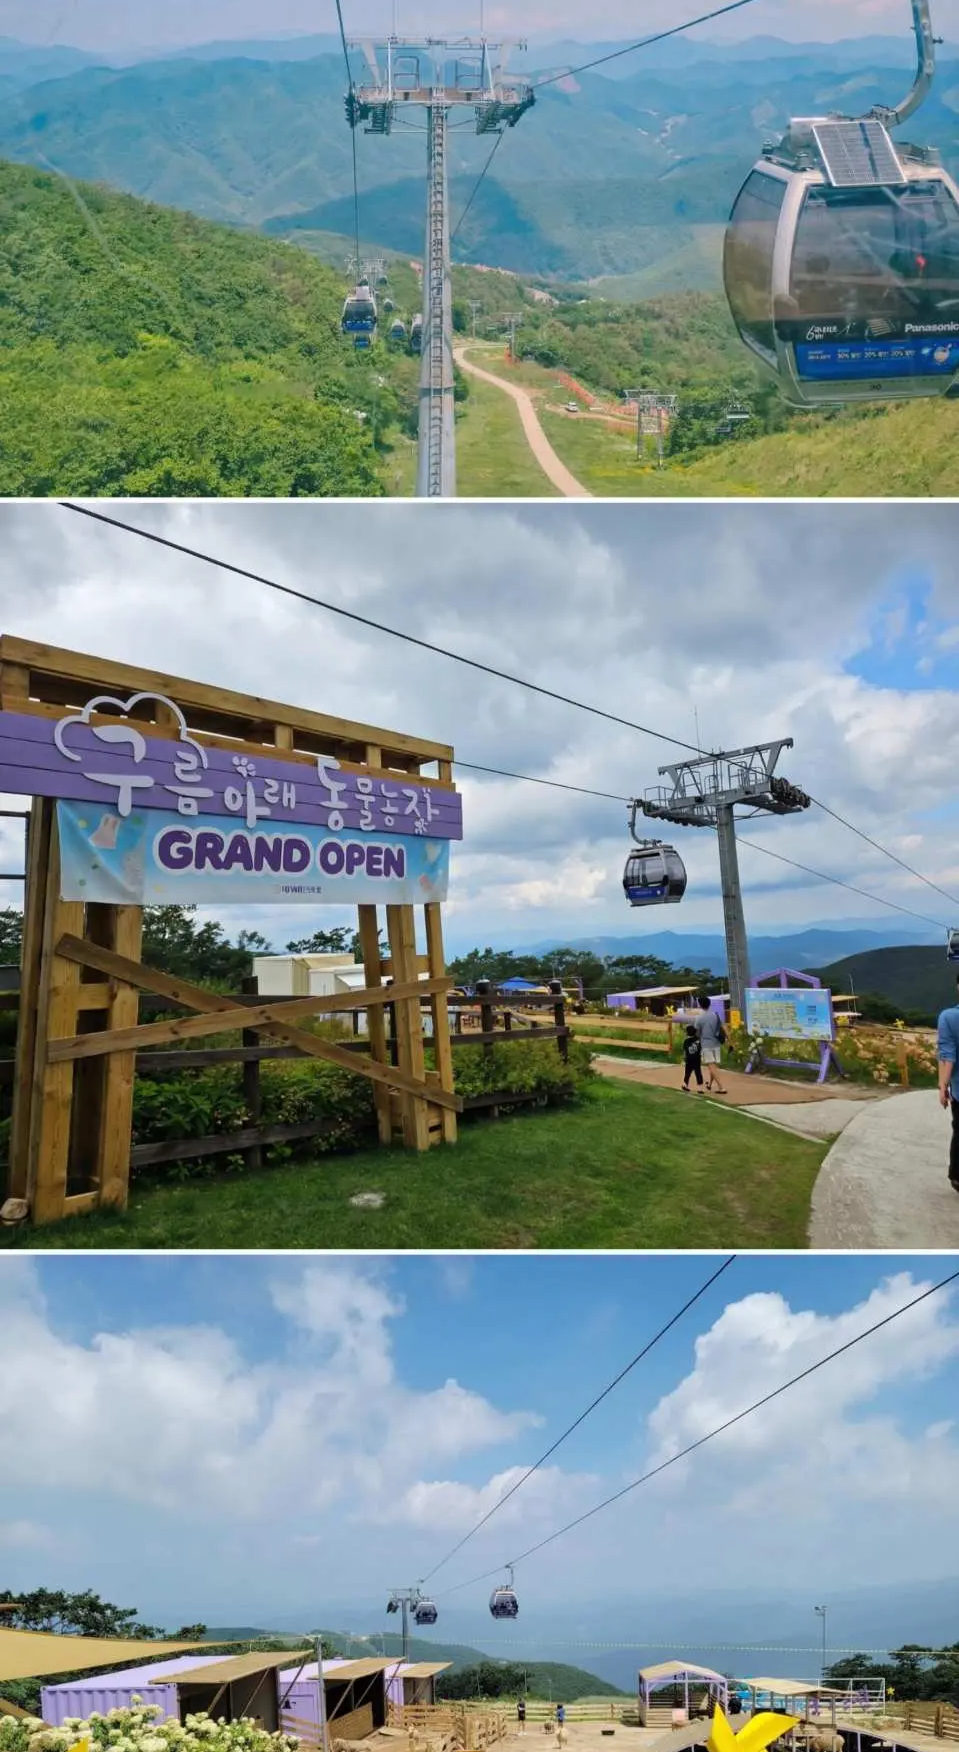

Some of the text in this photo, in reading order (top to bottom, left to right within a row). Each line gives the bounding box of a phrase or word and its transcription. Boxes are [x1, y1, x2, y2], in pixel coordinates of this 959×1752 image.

[904, 321, 959, 334] Panasonic
[157, 829, 406, 879] GRAND OPEN
